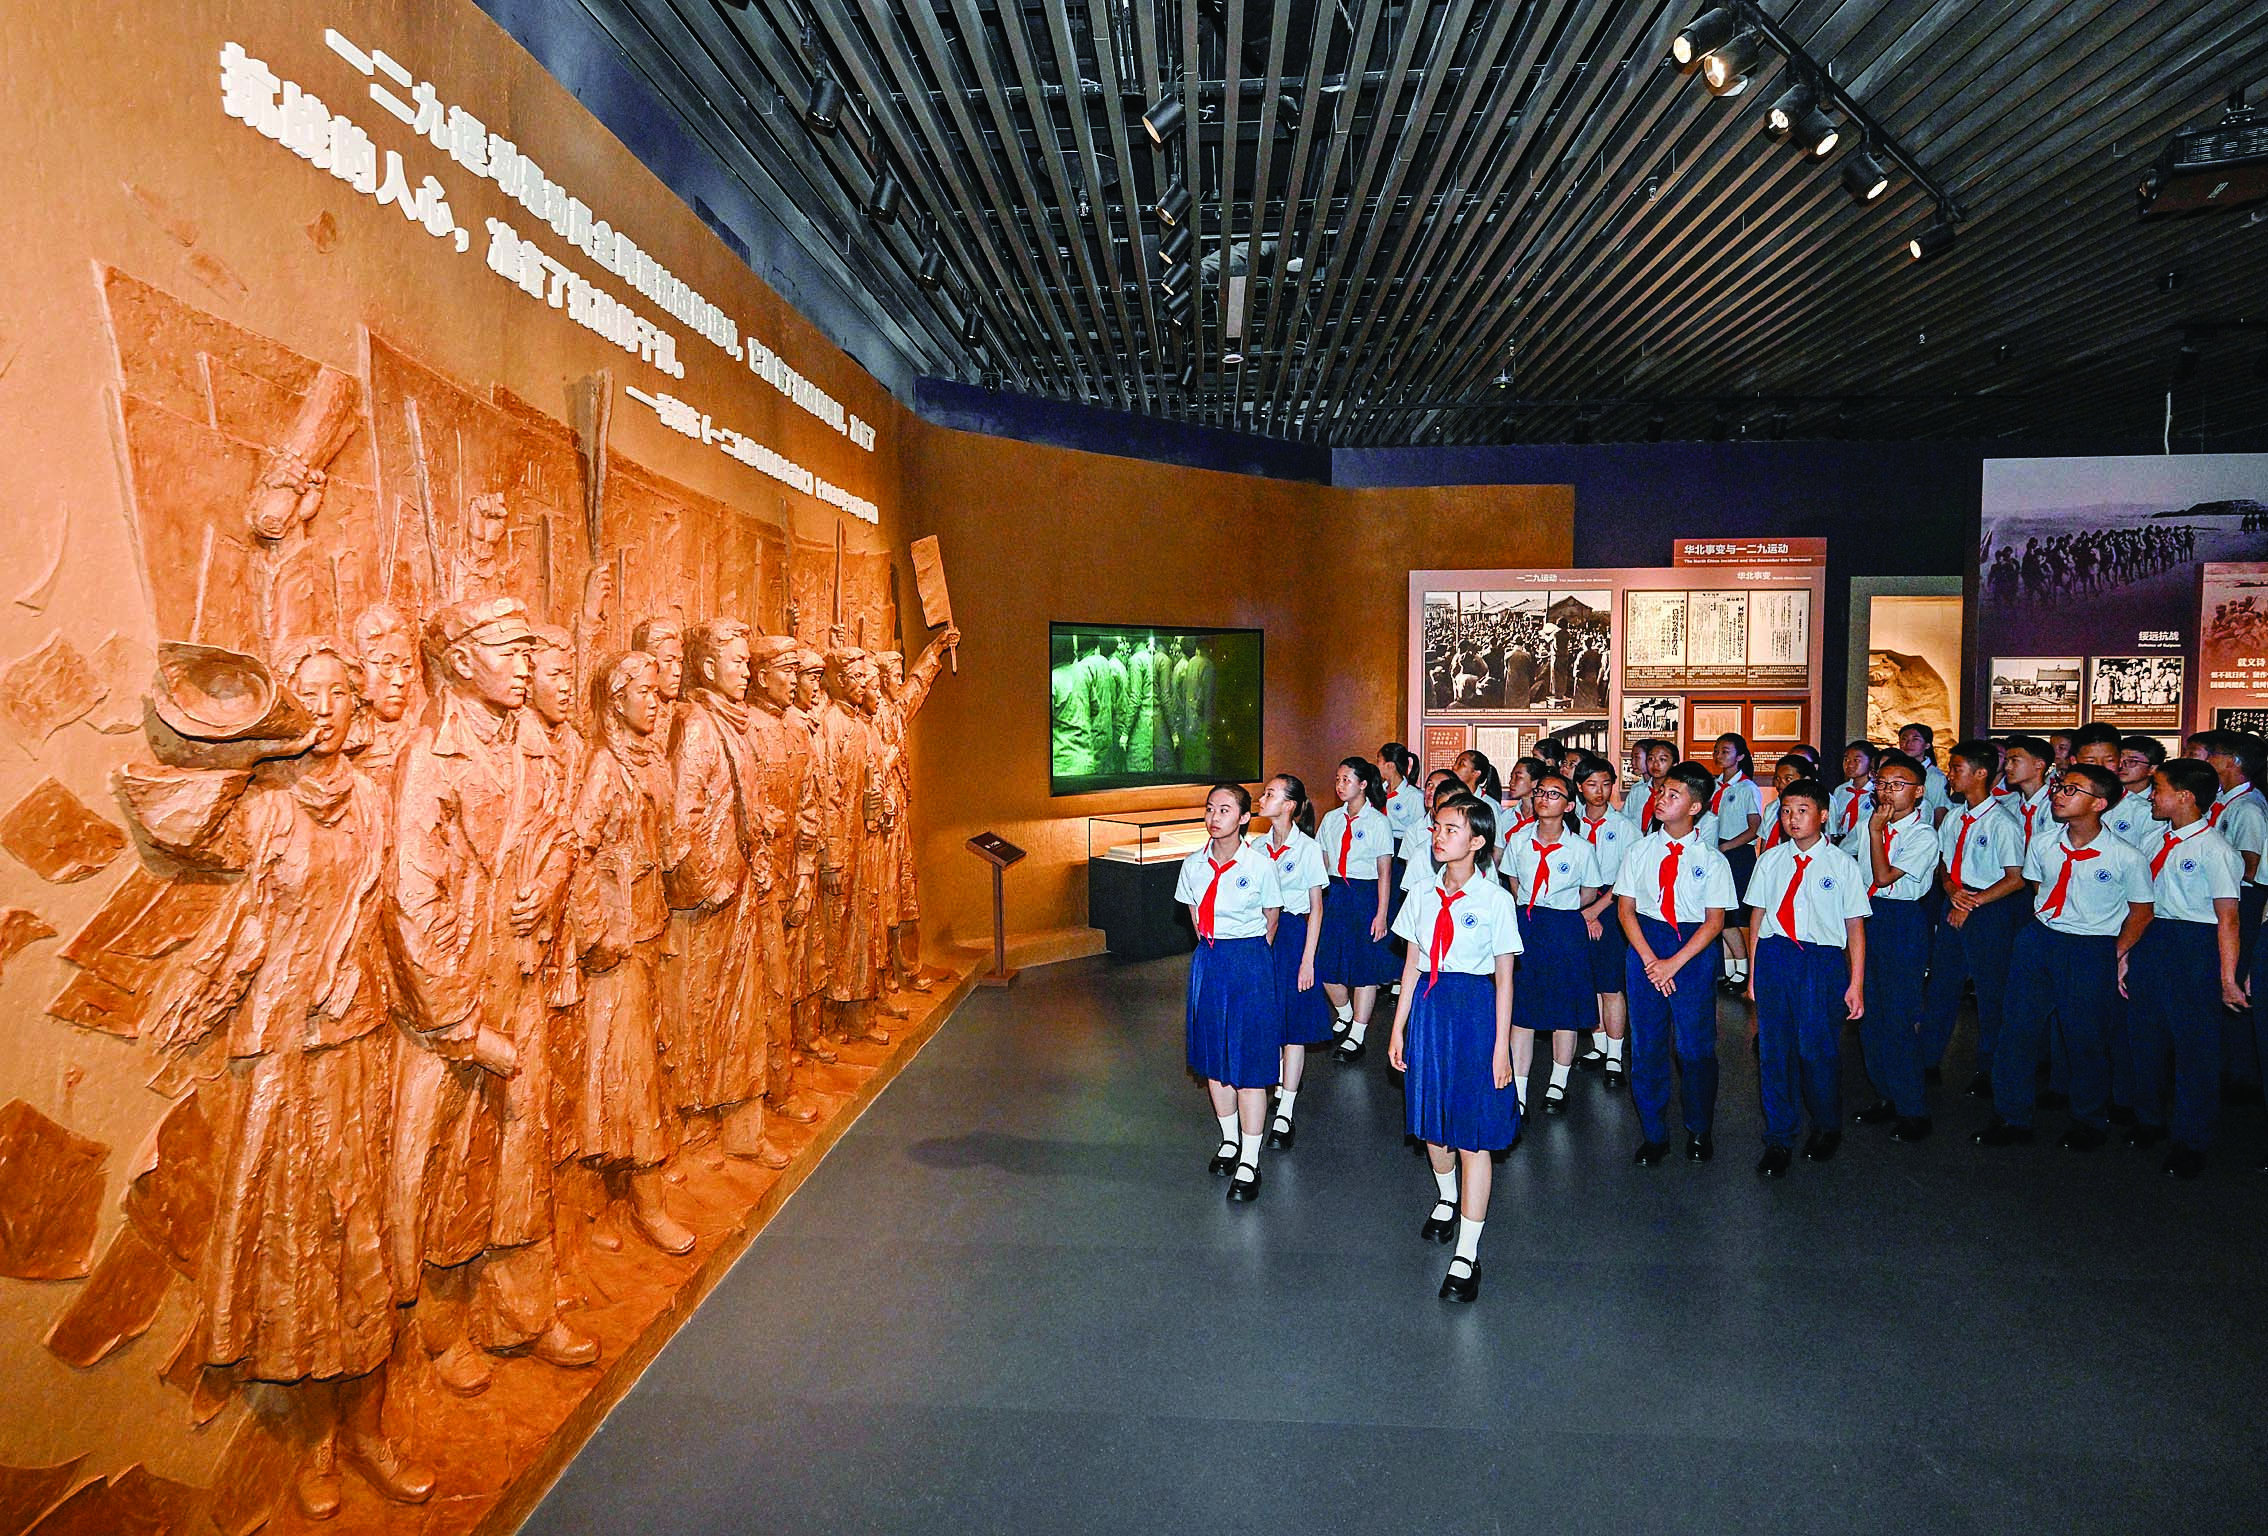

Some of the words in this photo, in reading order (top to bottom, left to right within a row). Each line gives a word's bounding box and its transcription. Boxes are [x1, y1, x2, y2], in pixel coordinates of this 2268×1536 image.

[1684, 544, 1788, 555] 华北事变与一二九运动
[1516, 574, 1557, 582] 一二九运动
[1736, 571, 1771, 580] 华北事变
[2138, 631, 2180, 641] 绥远抗战
